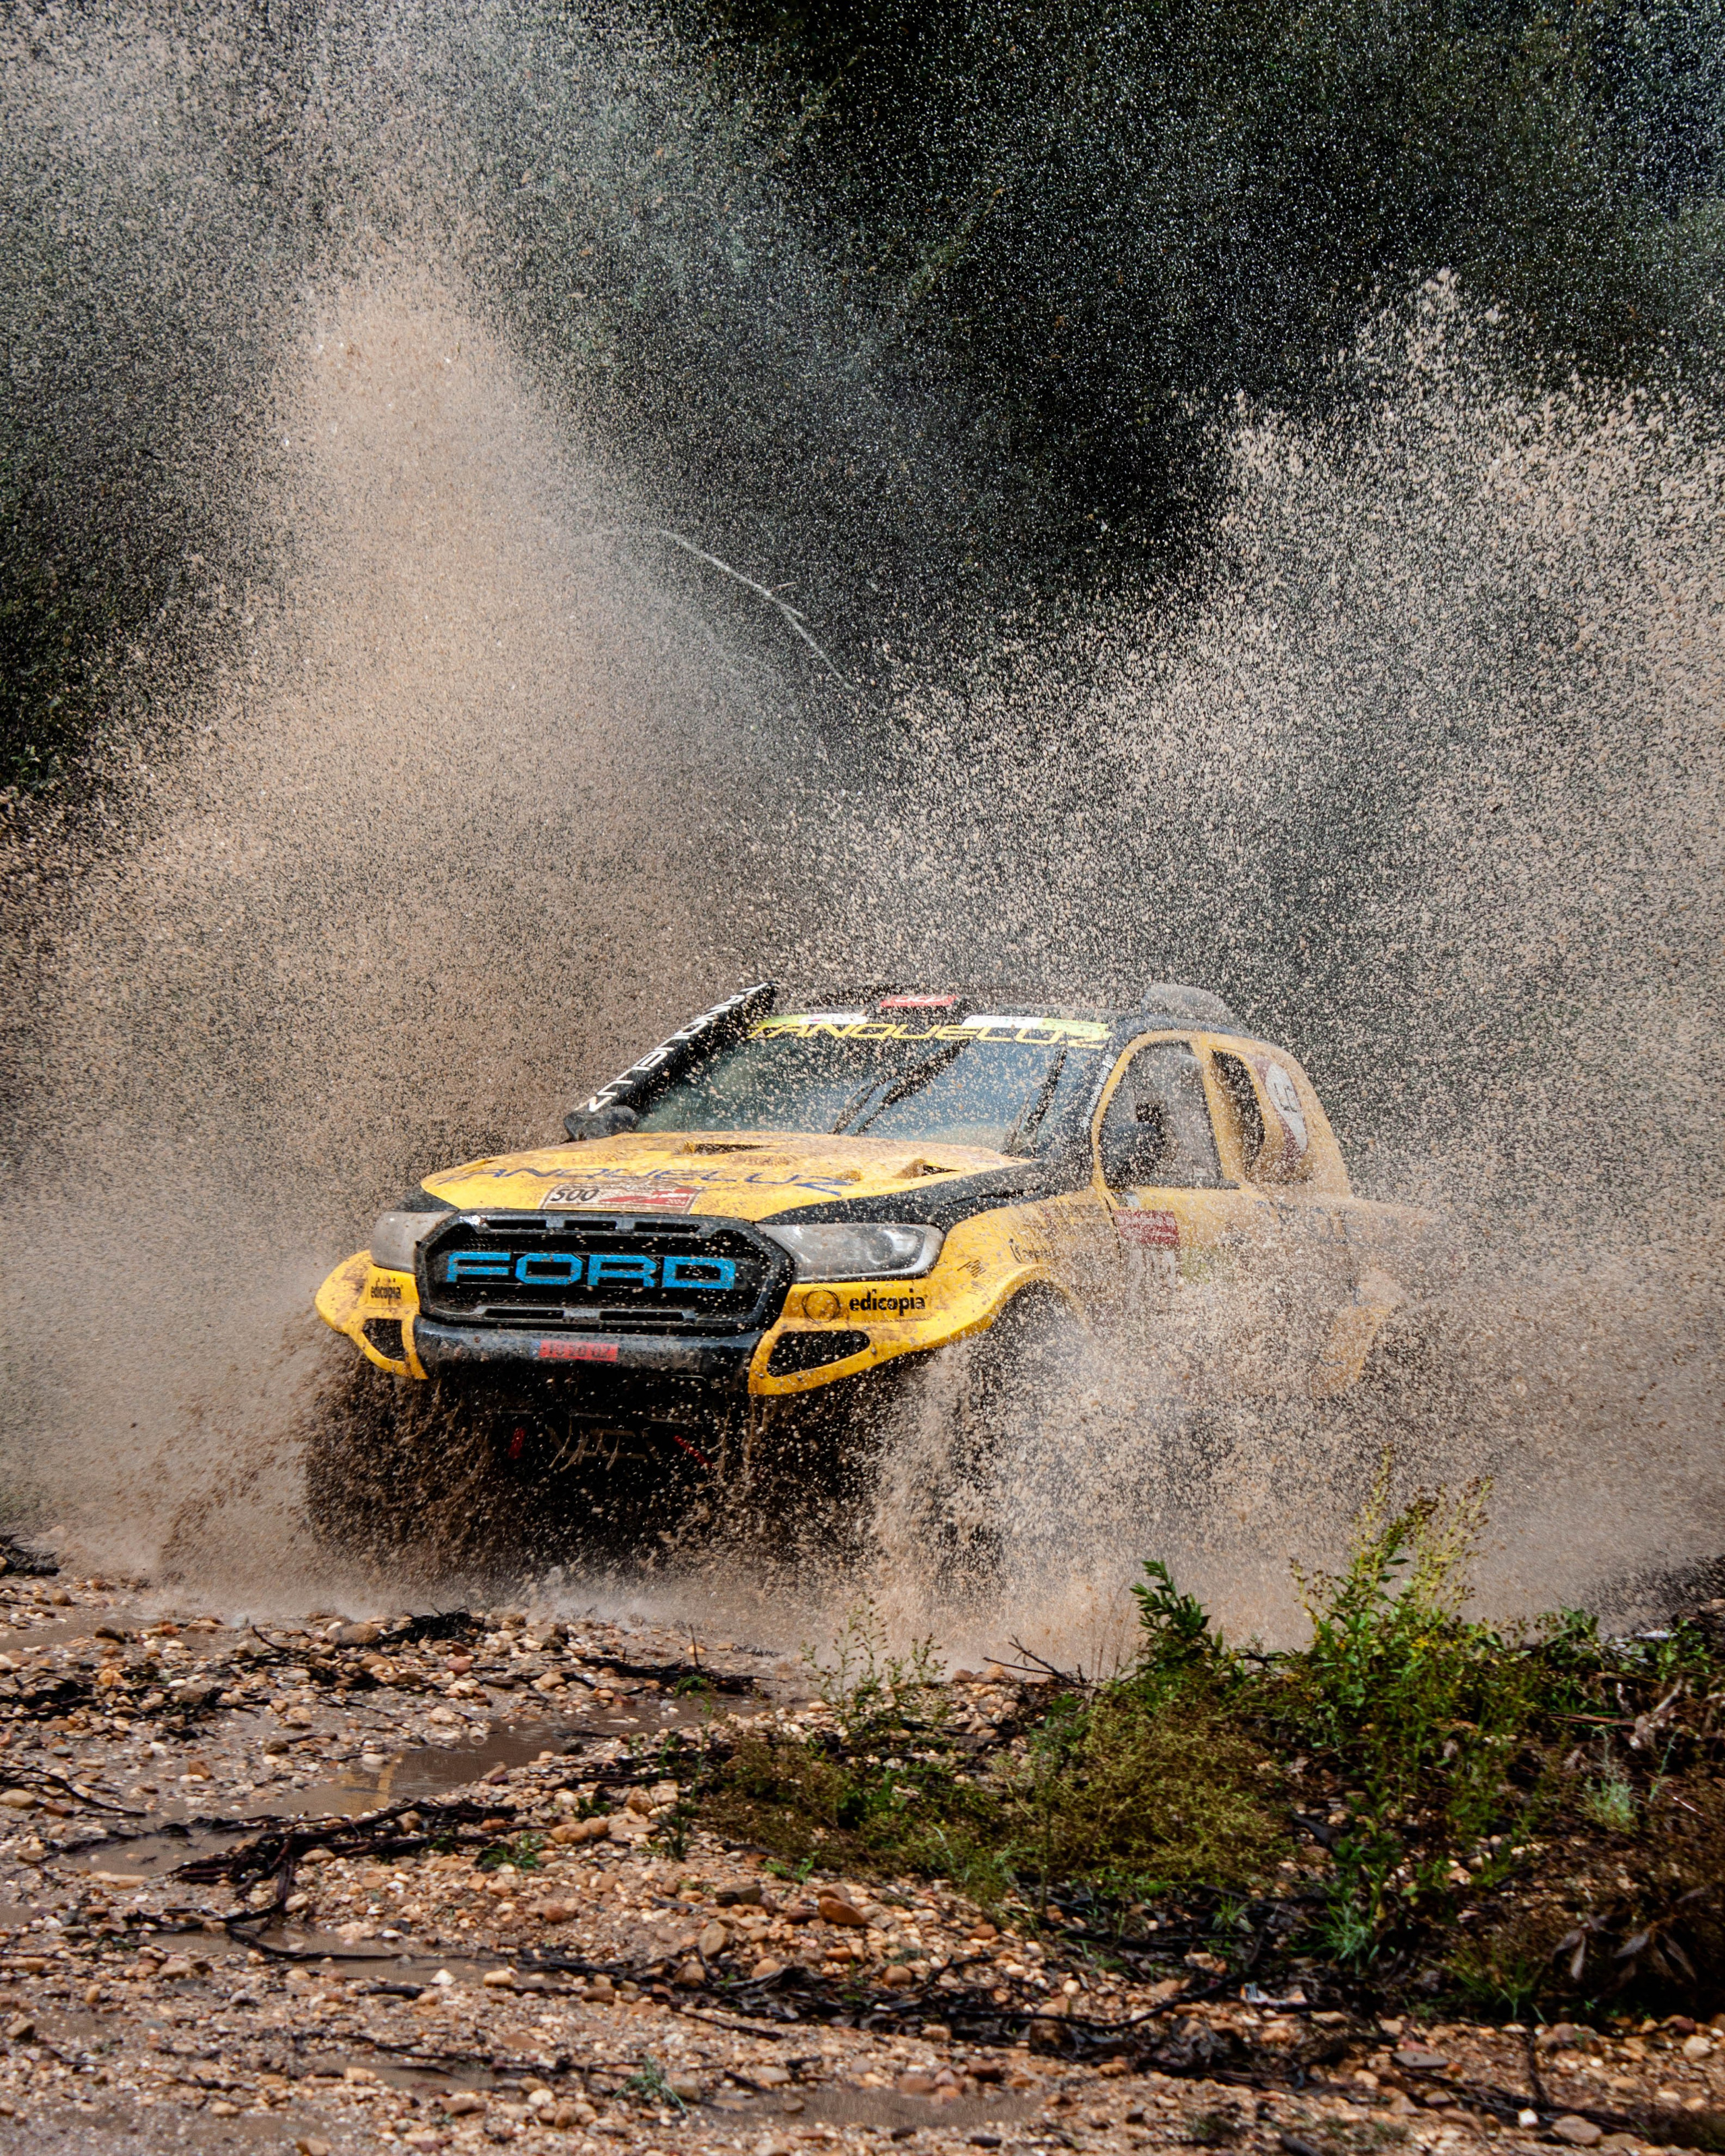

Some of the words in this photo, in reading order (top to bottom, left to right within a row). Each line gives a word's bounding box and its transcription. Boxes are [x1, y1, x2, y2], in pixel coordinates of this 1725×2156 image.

[746, 1021, 1112, 1050] TANQUELUZ
[551, 1188, 600, 1202] 500
[446, 1251, 736, 1290] FORD
[848, 1288, 926, 1316] edicopia
